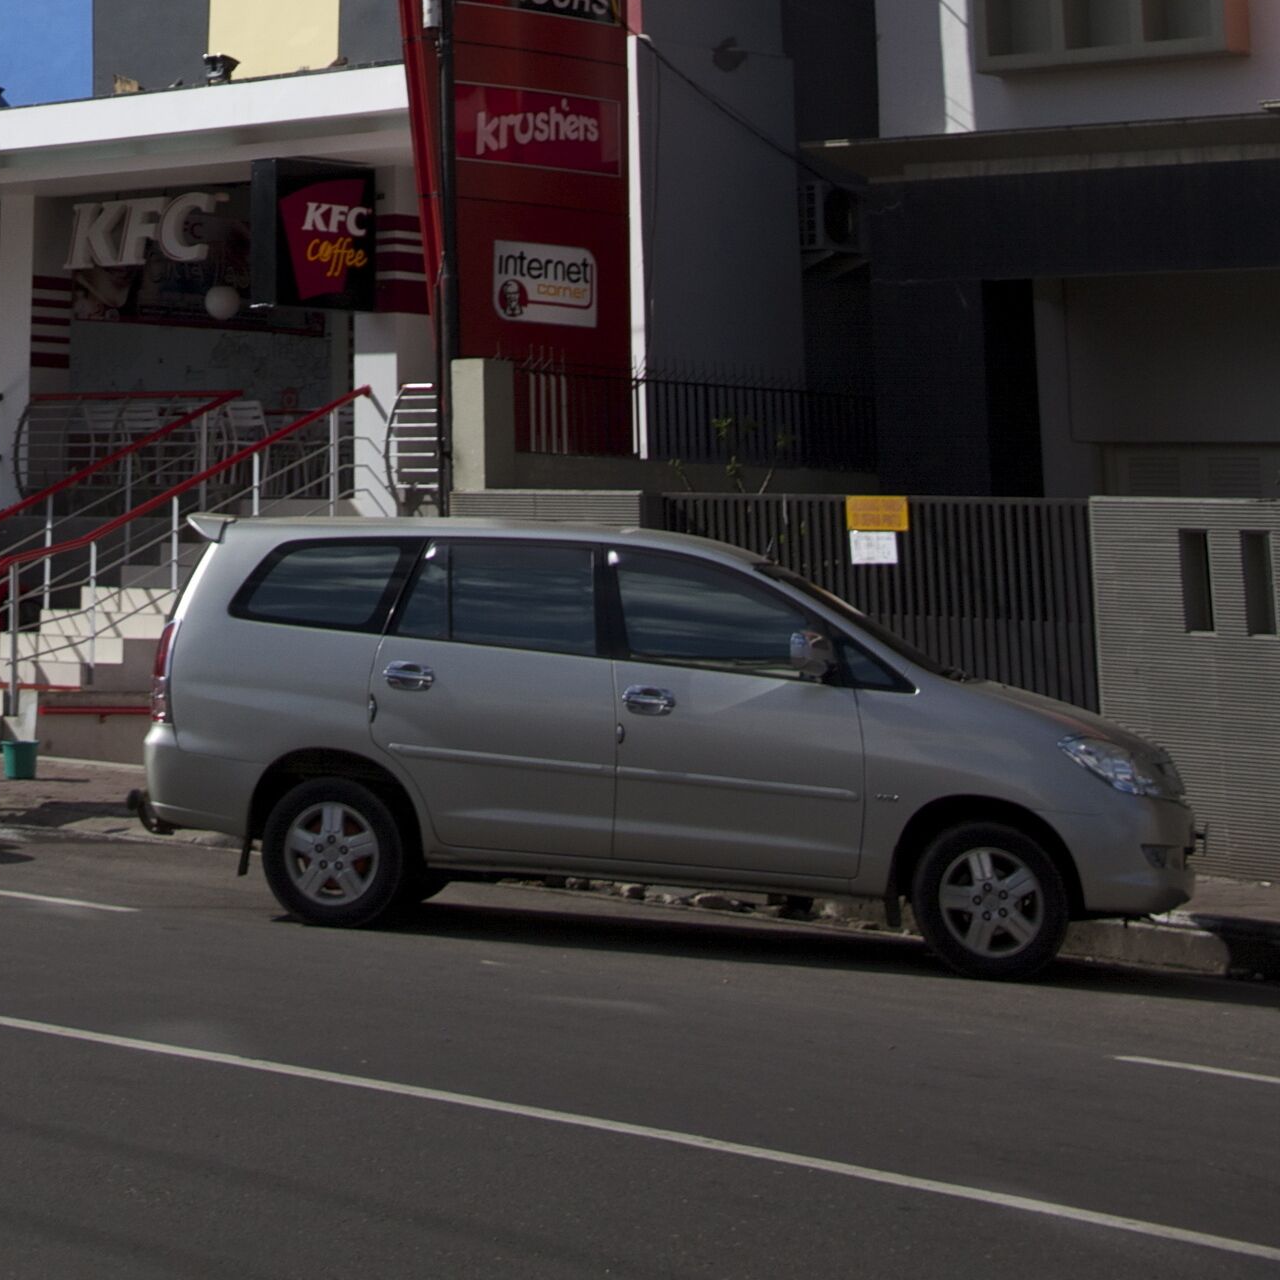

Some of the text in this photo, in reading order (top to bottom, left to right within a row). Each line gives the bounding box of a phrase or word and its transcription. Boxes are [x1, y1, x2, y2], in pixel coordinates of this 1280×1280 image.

[475, 102, 599, 156] krushers
[64, 191, 218, 270] KFC
[302, 202, 368, 238] KFC
[498, 251, 590, 284] internet
[537, 283, 587, 300] corner
